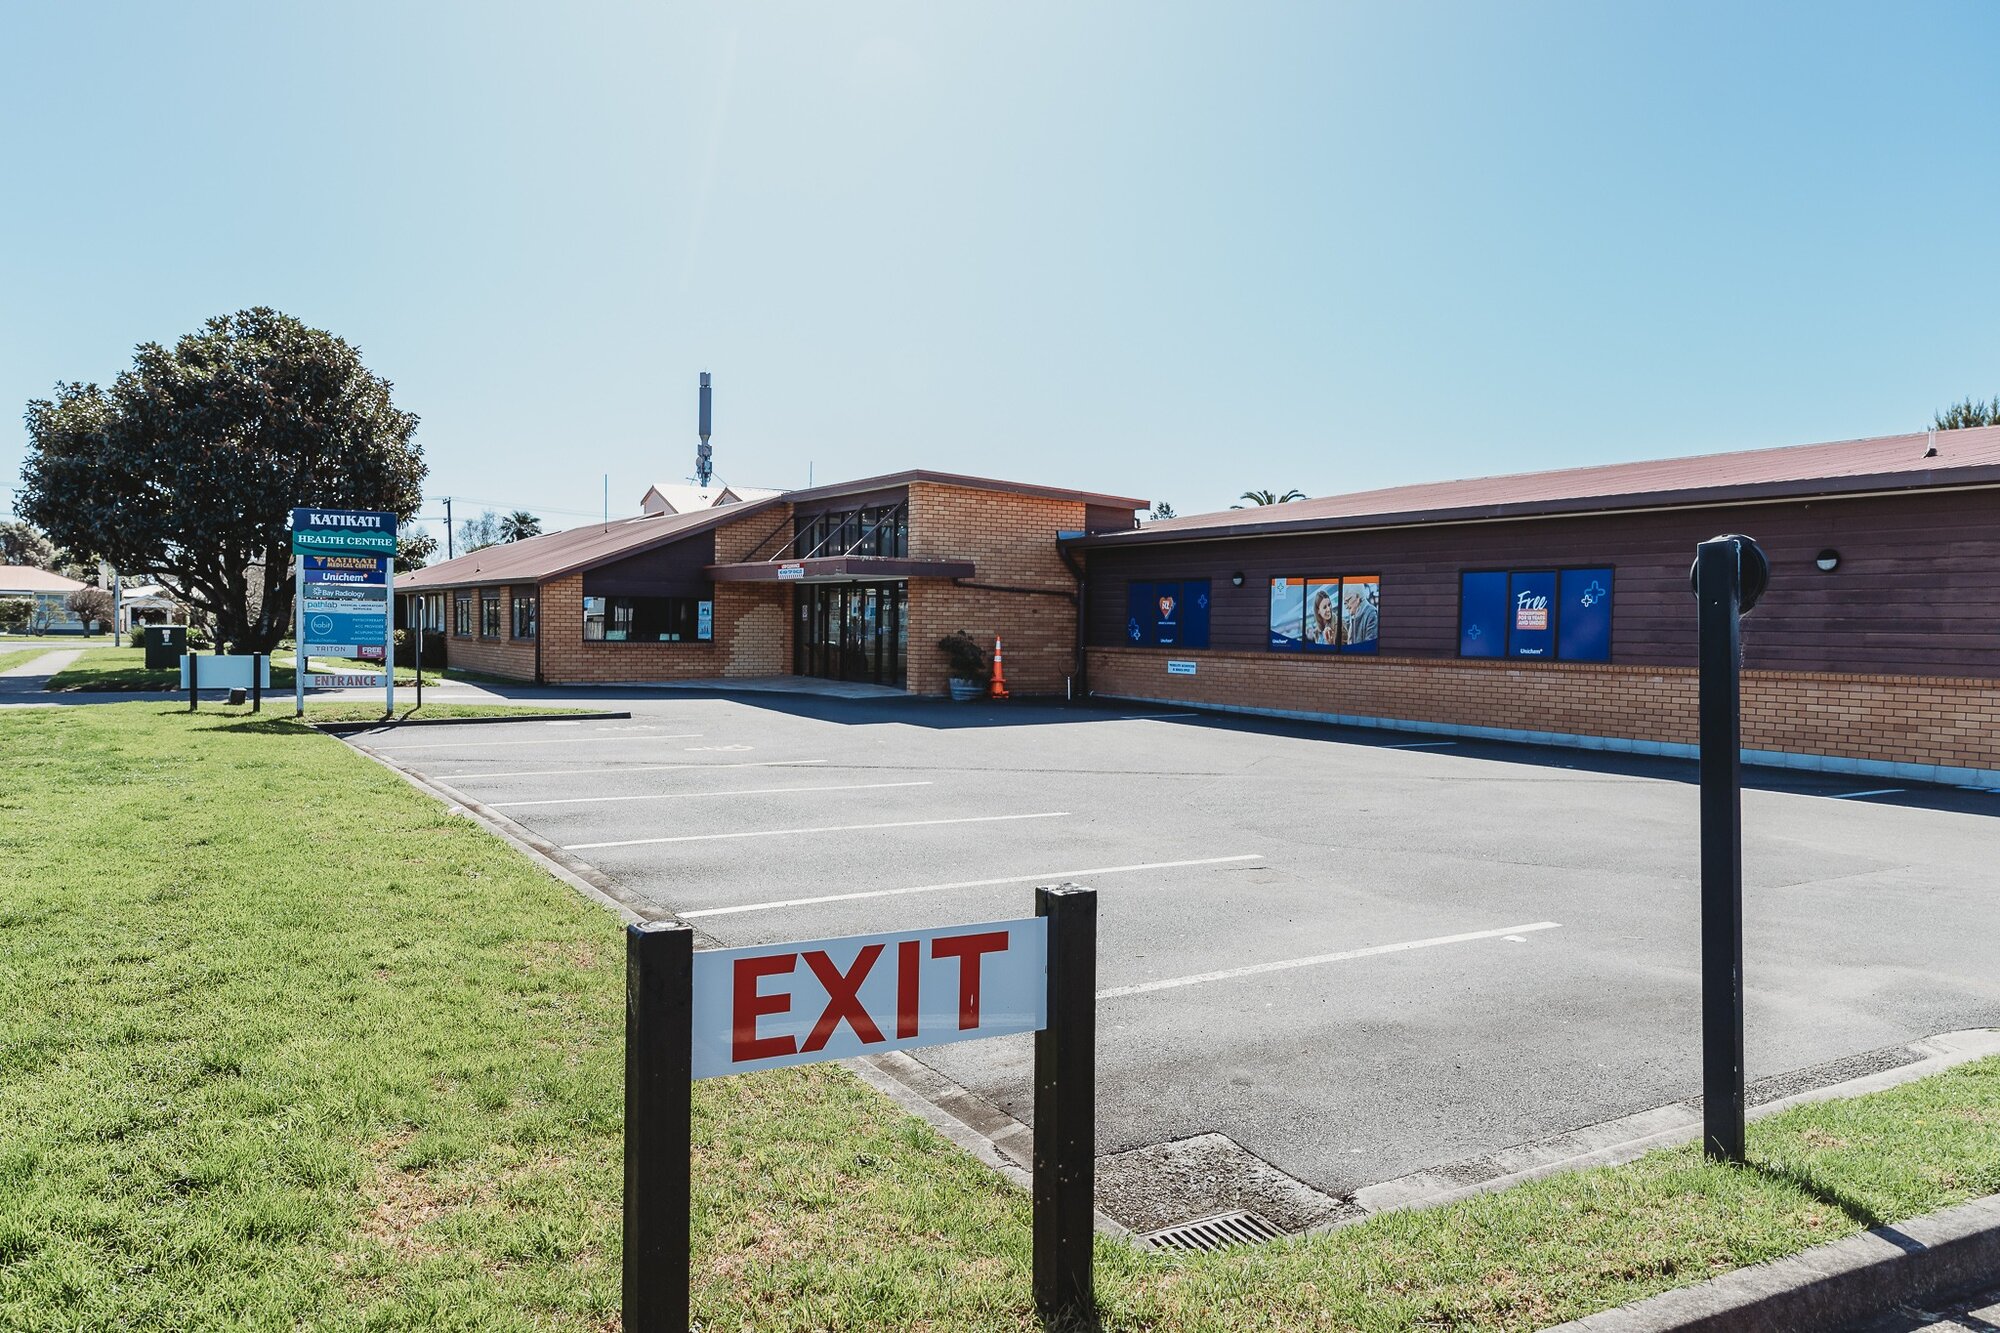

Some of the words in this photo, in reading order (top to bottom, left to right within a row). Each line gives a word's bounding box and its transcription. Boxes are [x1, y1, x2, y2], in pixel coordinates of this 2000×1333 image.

[310, 513, 381, 527] KATIKATI
[298, 535, 344, 545] HEALTH
[347, 537, 393, 546] CENTRE
[327, 556, 377, 564] KATIKATI
[323, 573, 364, 582] Unichem
[322, 589, 334, 597] Bay
[335, 590, 365, 598] Radiology
[307, 601, 338, 609] pathlab
[1517, 590, 1548, 611] Free
[314, 675, 376, 686] ENTRANCE
[732, 930, 1009, 1063] EXIT
